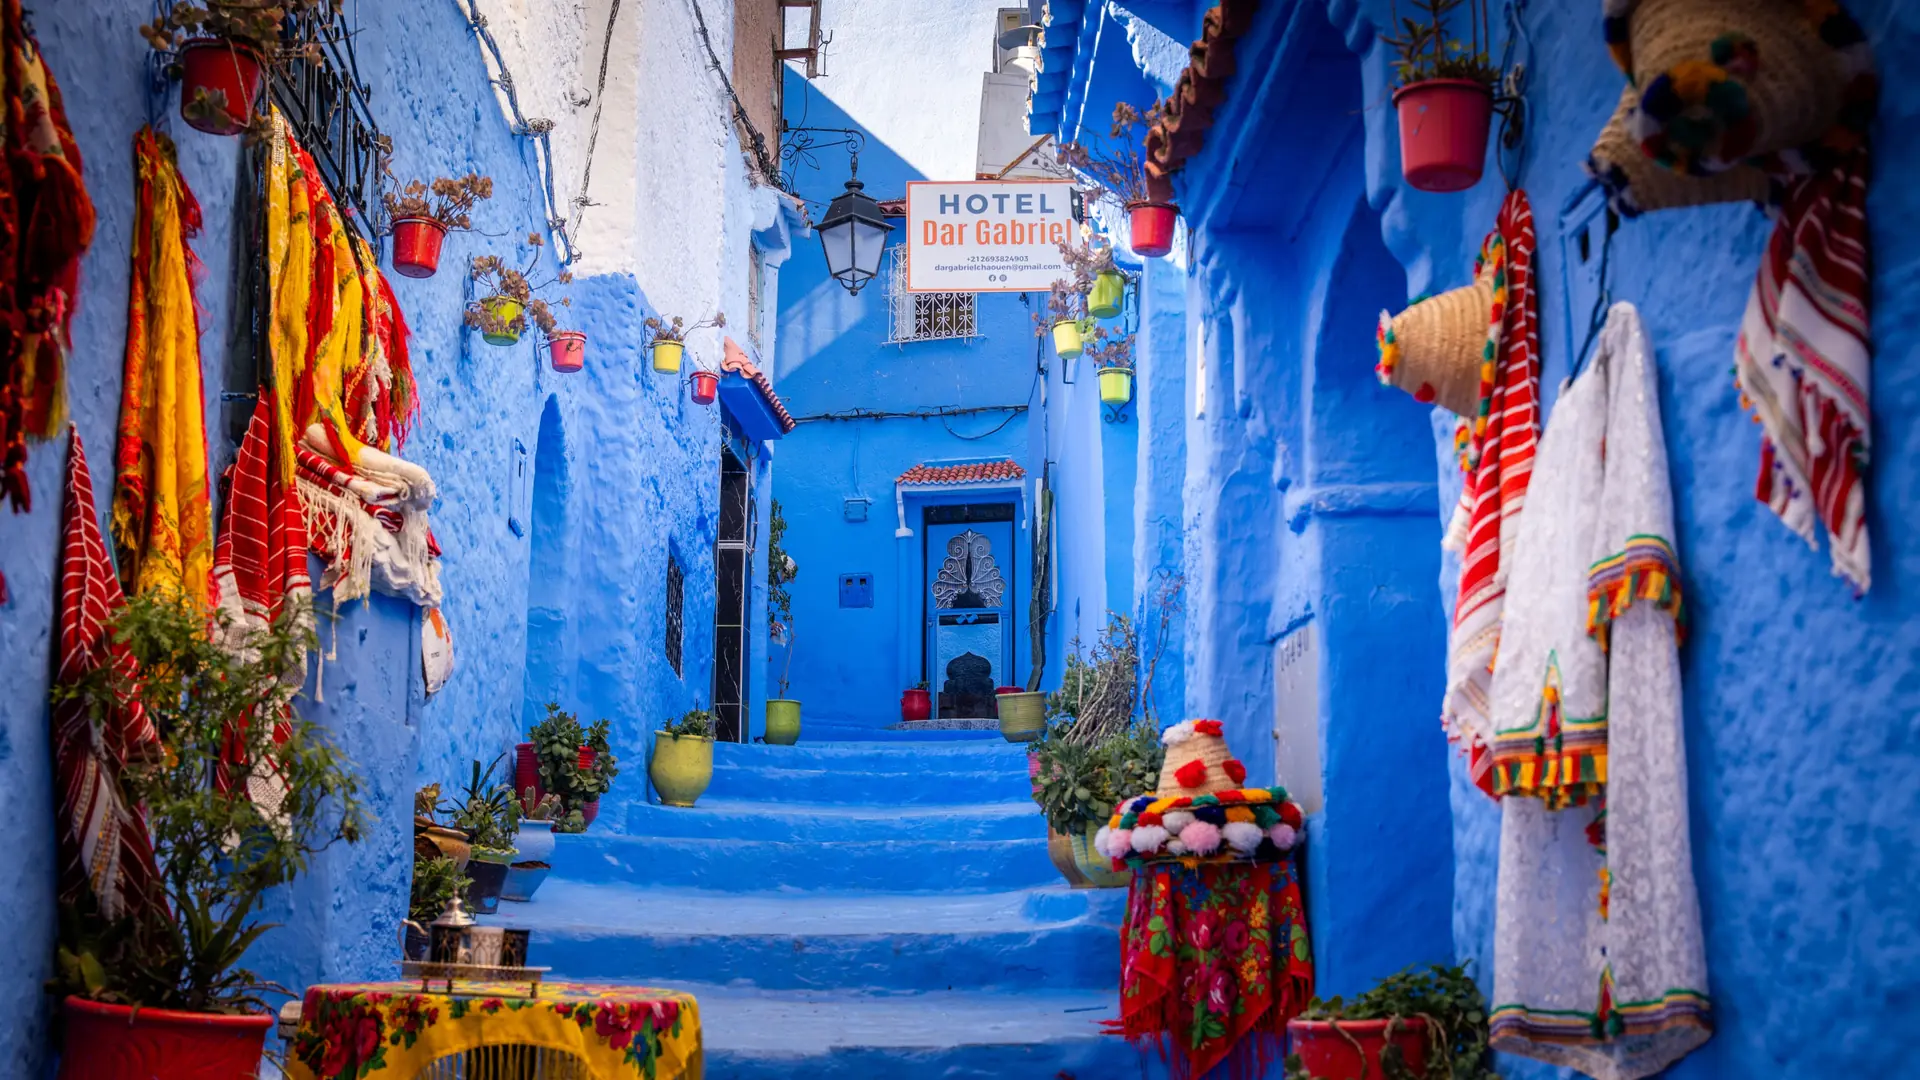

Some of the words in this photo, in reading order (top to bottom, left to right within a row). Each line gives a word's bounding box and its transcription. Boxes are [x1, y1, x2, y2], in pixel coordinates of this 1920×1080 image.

[939, 194, 1055, 214] HOTEL
[923, 220, 967, 246] Dar
[976, 217, 1072, 245] Gabriel
[934, 262, 1061, 273] dargabrielchaouen@gmail.com
